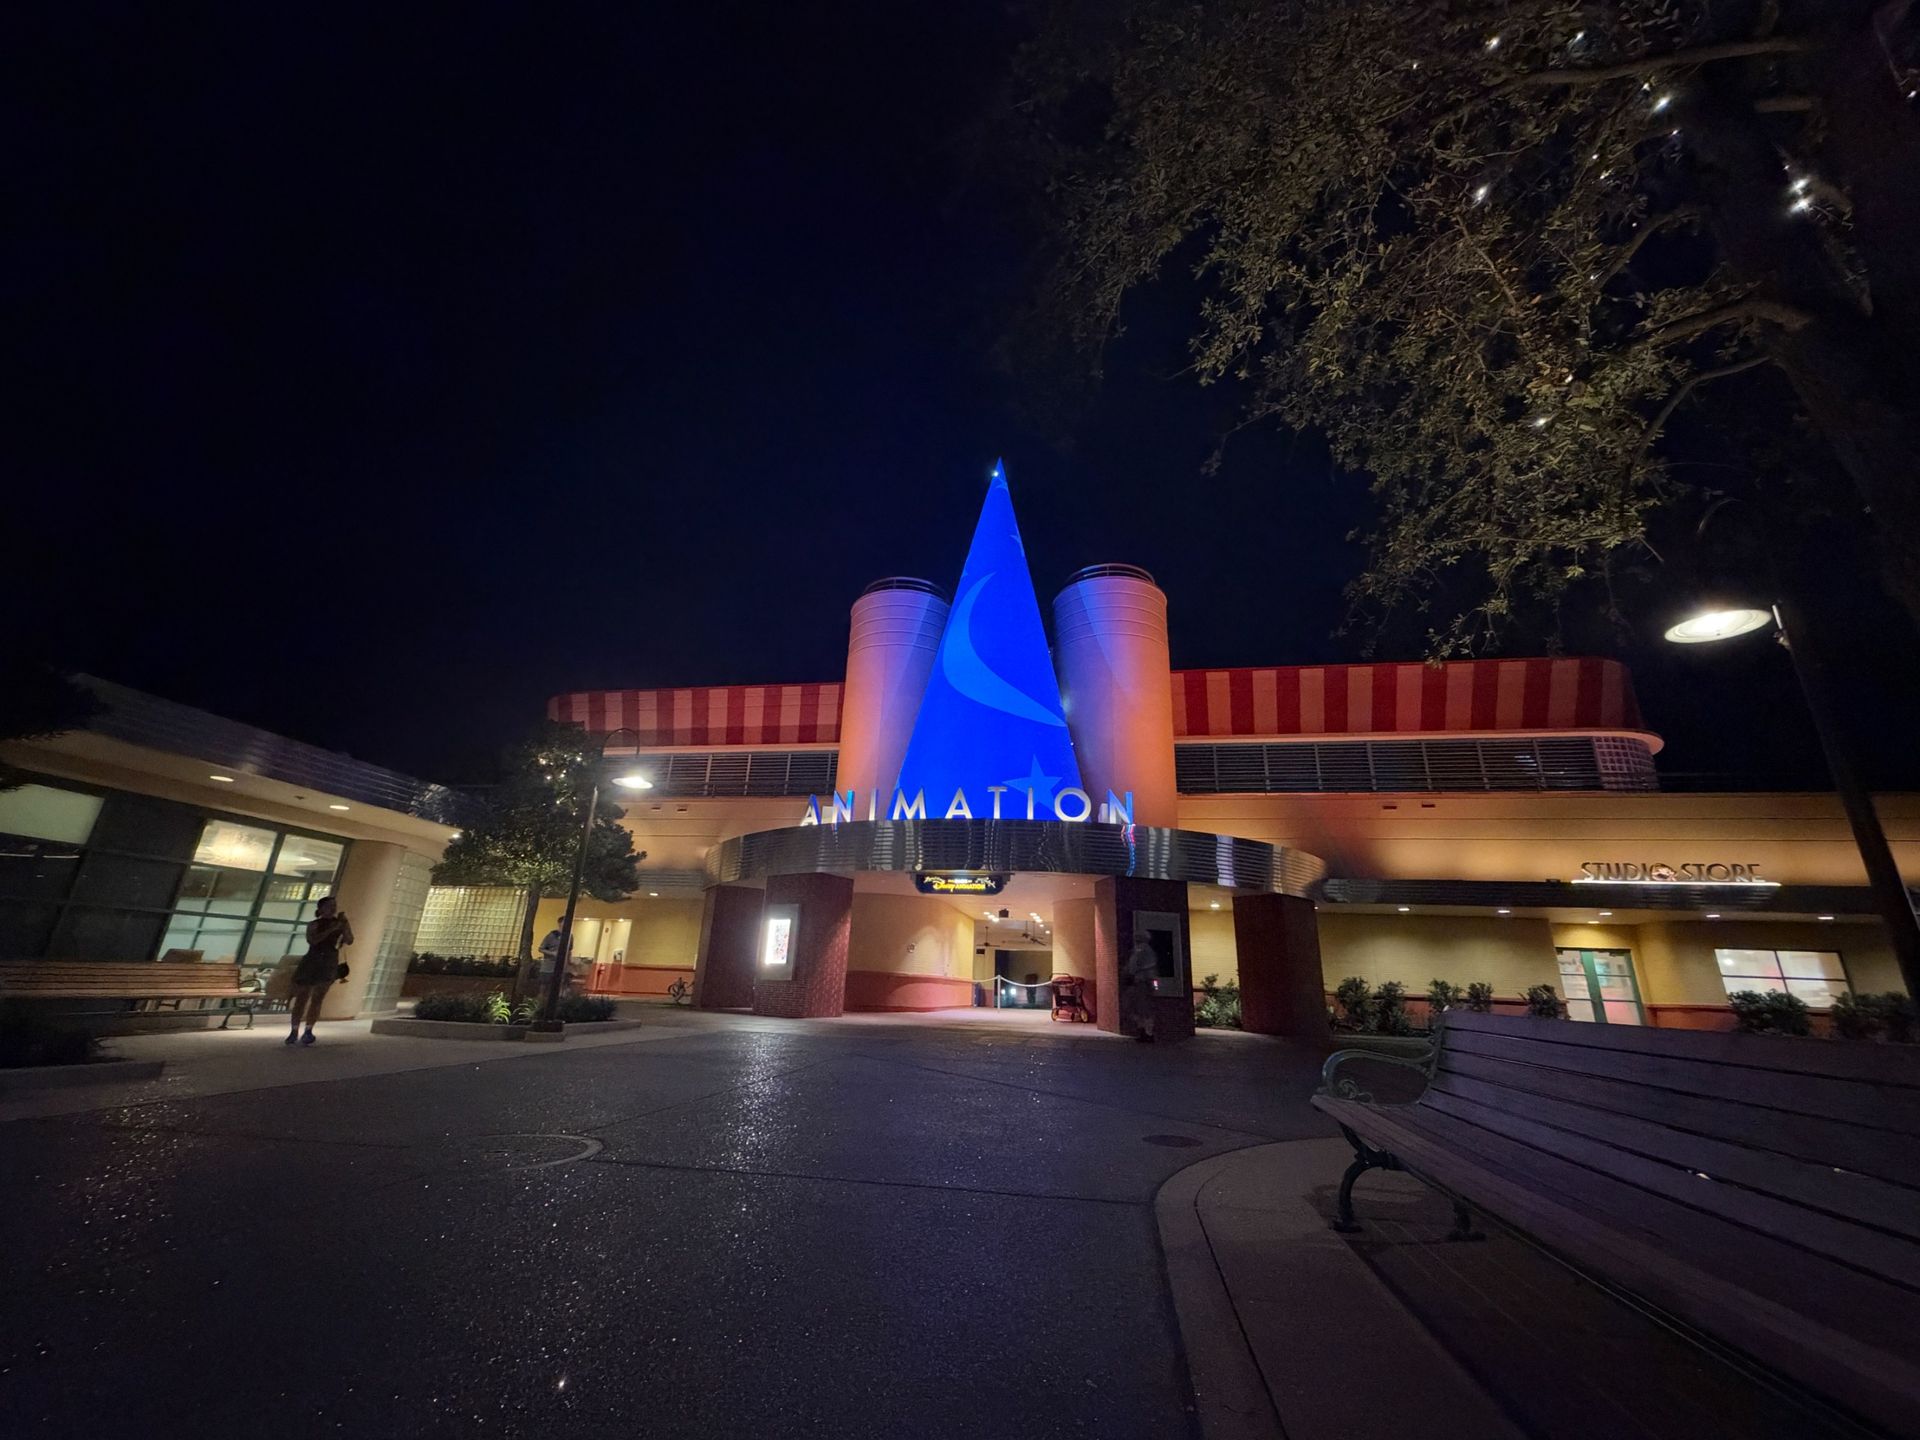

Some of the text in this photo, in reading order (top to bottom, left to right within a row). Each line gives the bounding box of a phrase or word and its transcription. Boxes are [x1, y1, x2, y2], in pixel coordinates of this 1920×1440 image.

[800, 786, 1135, 827] ANIMATION
[1581, 862, 1767, 883] STUDIO STORE
